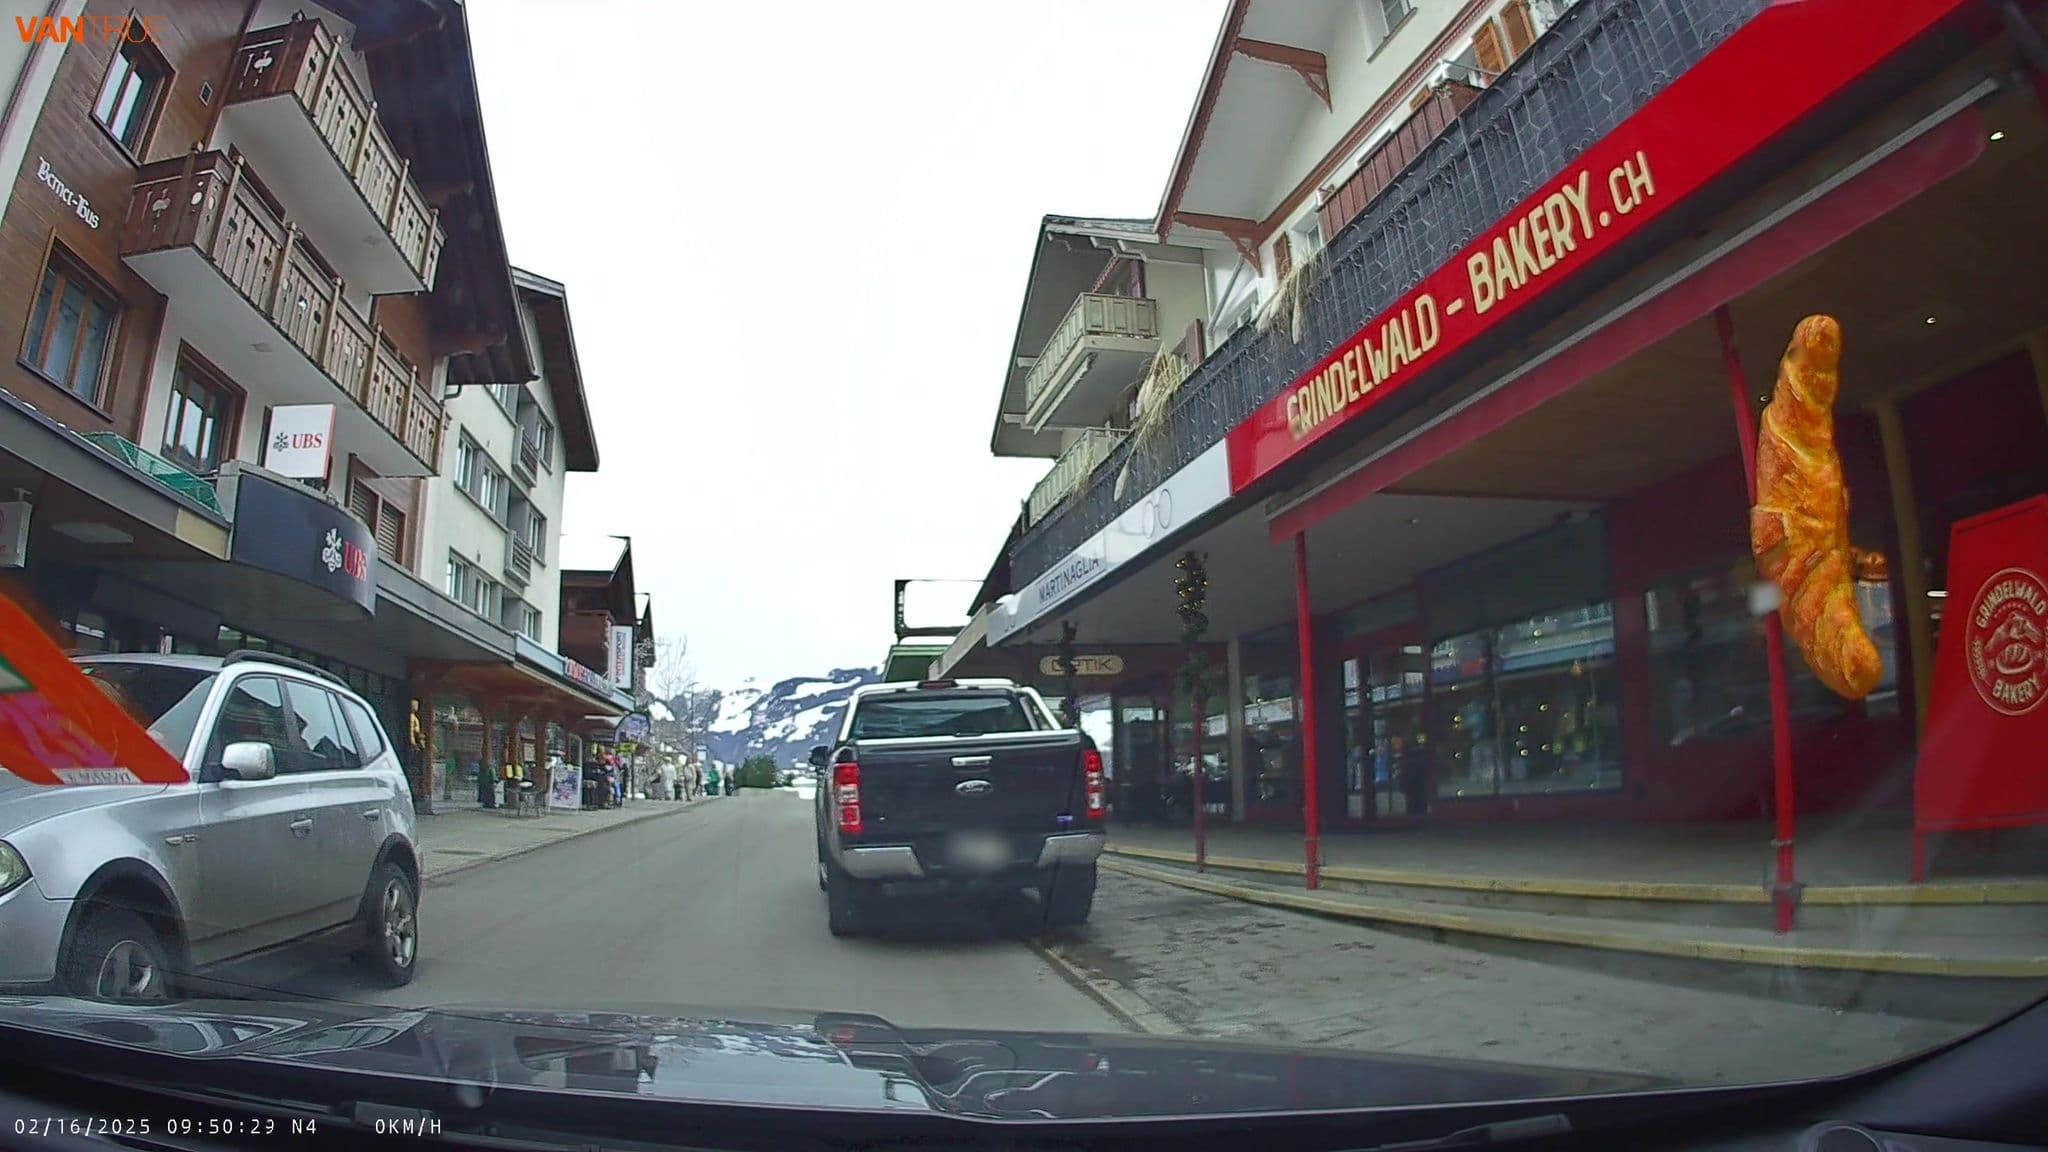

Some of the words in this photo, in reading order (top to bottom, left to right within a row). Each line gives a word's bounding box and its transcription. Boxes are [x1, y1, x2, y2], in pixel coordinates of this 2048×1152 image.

[1286, 294, 1440, 440] GRINDELWALD
[292, 433, 323, 449] UBS
[344, 541, 367, 583] UBS
[1039, 556, 1099, 603] MARTINAGLIA
[1976, 580, 2046, 628] GRINDELWALD
[1992, 671, 2040, 704] BAKERY
